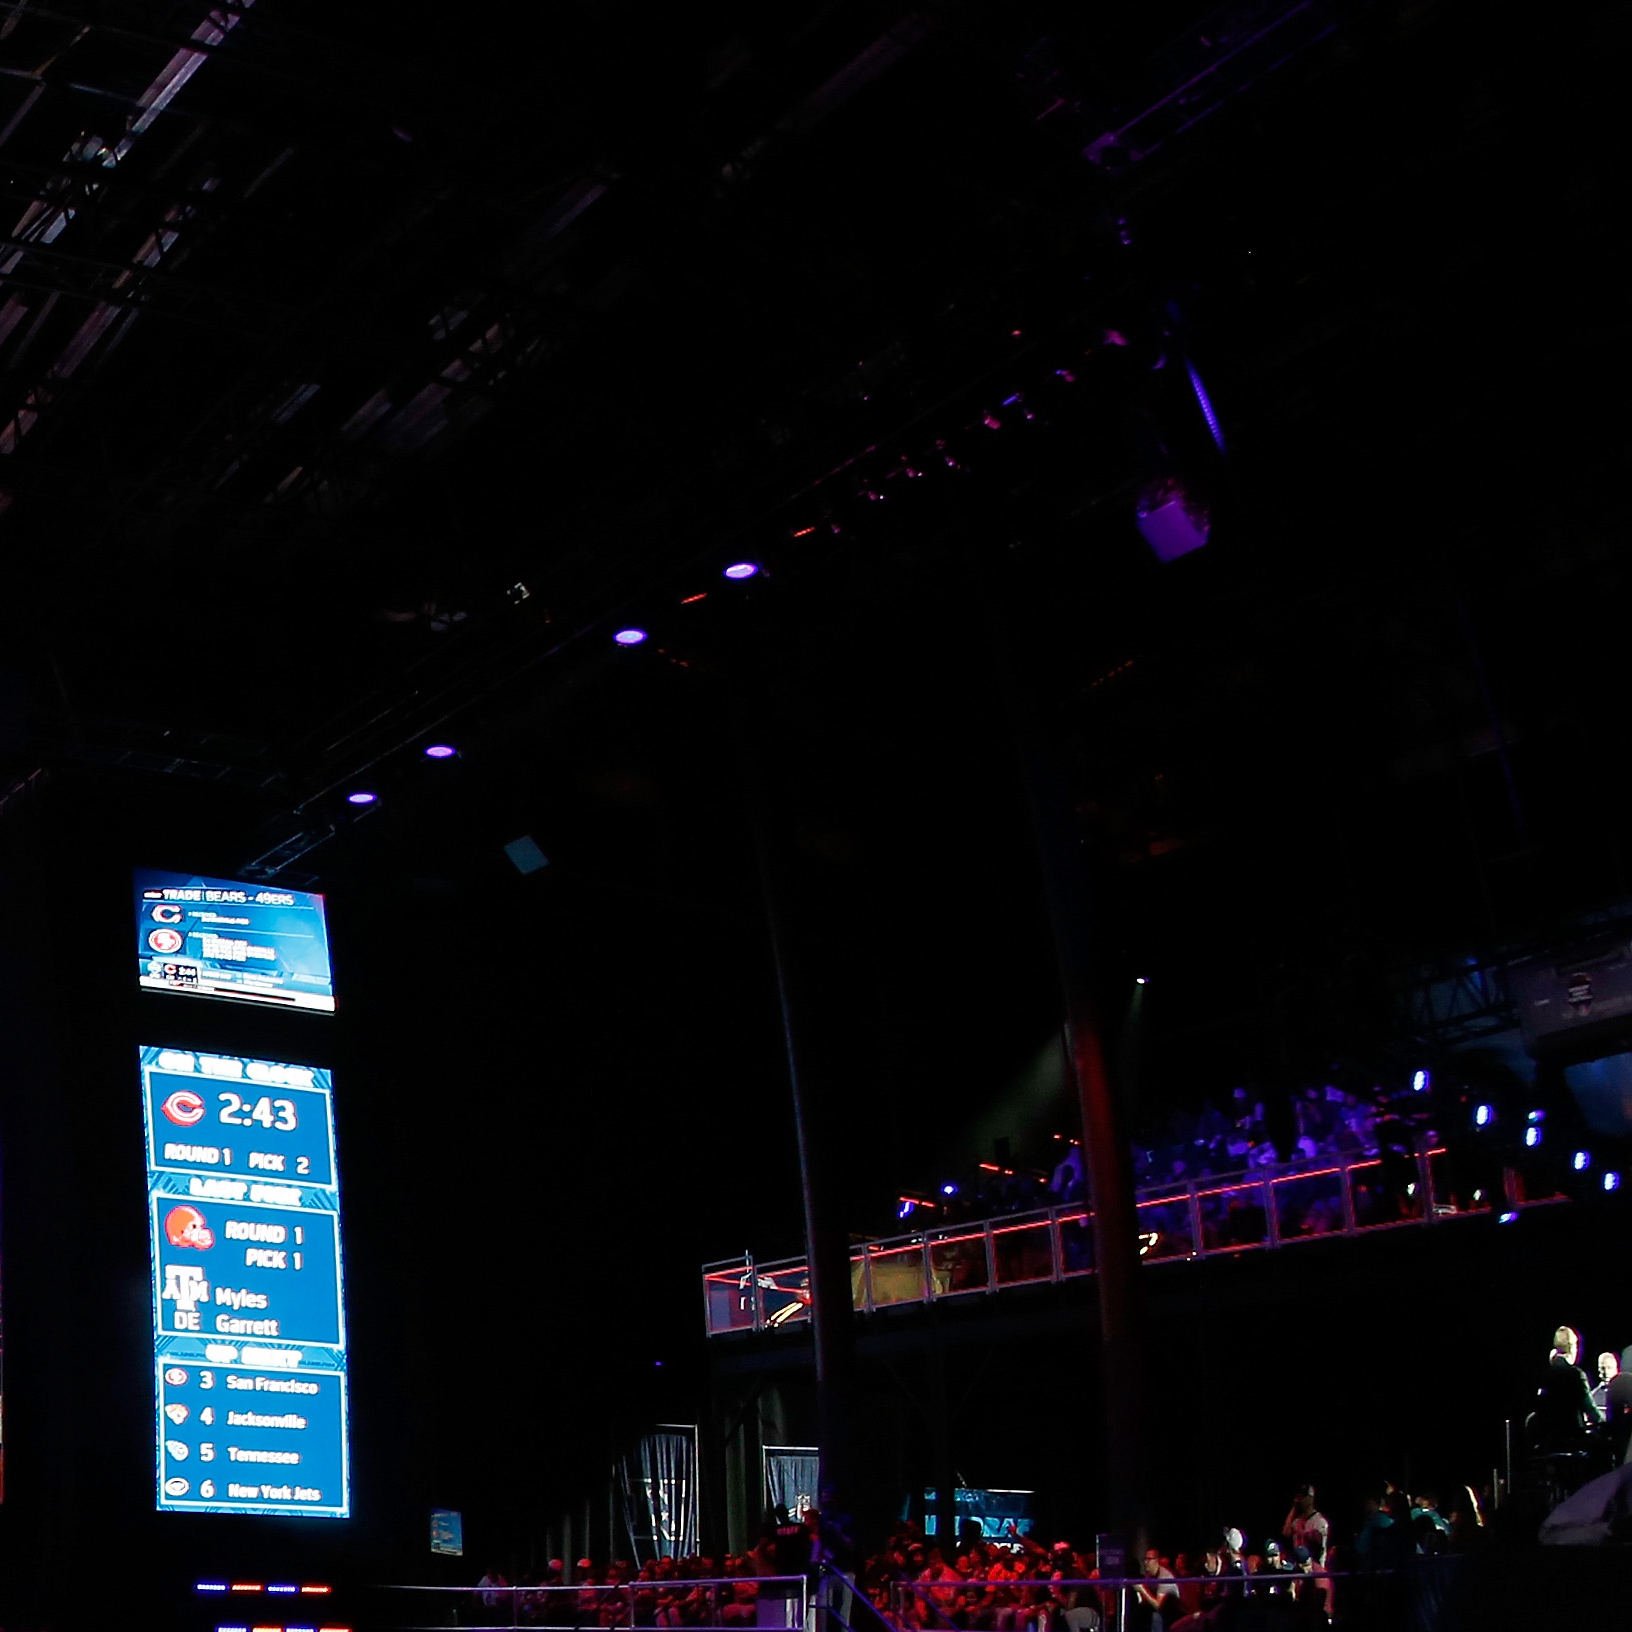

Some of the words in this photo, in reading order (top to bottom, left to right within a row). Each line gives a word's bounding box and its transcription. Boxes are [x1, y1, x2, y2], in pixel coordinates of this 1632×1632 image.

[162, 889, 201, 902] TRADE
[205, 891, 247, 904] BEARS
[218, 1091, 298, 1132] 2:43
[164, 1142, 221, 1165] ROUND
[248, 1152, 286, 1173] PICK
[296, 1156, 311, 1174] 2
[225, 1220, 287, 1244] ROUND
[293, 1226, 304, 1245] 1
[245, 1248, 286, 1270] PICK
[293, 1252, 304, 1271] 1
[215, 1287, 269, 1312] Myles
[173, 1311, 201, 1331] DE
[216, 1314, 279, 1337] Garrett
[198, 1370, 215, 1390] 3
[226, 1374, 255, 1391] San
[255, 1377, 320, 1396] Francisco
[198, 1407, 215, 1426] 4
[226, 1411, 308, 1430] Jacksonville
[199, 1443, 215, 1463] 5
[227, 1446, 301, 1465] Tennessee
[199, 1479, 215, 1499] 6
[227, 1482, 260, 1500] New
[260, 1484, 293, 1501] York
[293, 1485, 322, 1502] Jets
